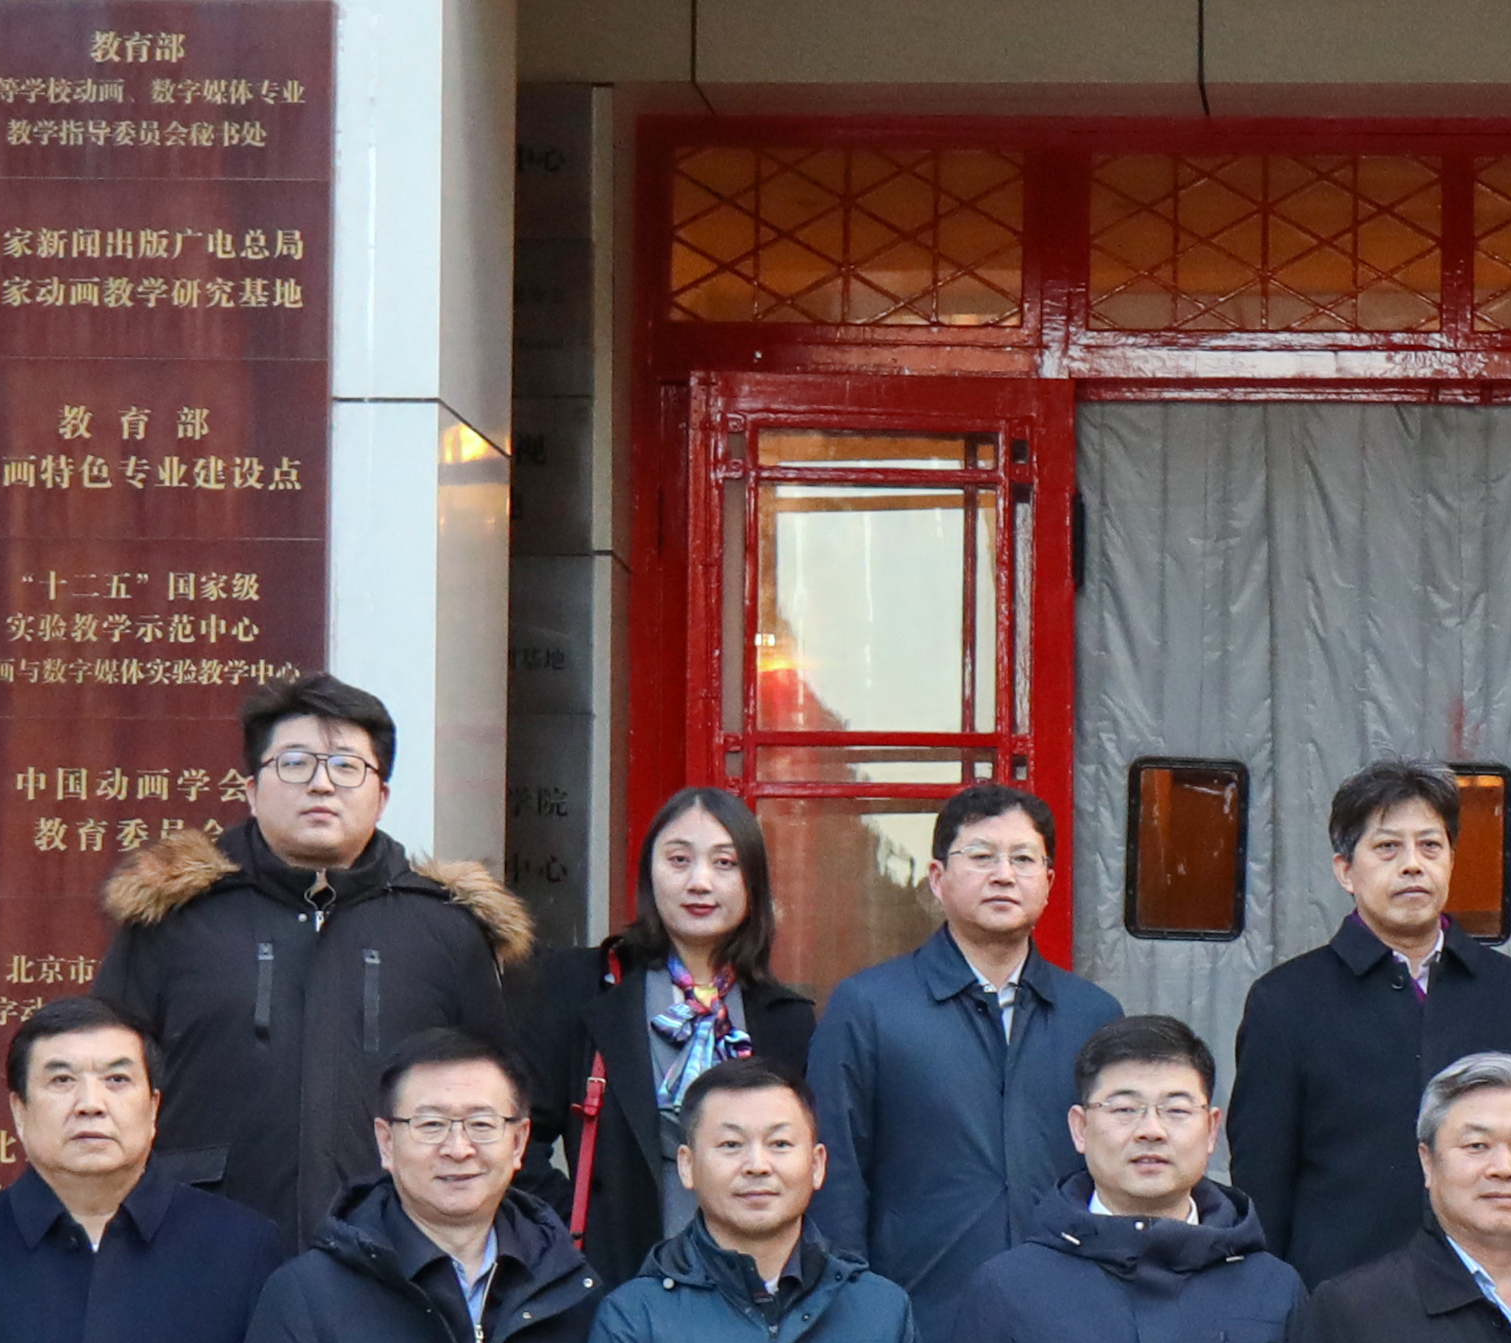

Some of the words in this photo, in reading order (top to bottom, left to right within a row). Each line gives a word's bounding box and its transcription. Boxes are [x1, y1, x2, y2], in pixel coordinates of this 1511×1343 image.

[90, 30, 186, 63] 教育部
[6, 119, 268, 147] 教学指导委员会秘书处
[5, 612, 261, 643] 实验教学示范中心
[15, 767, 248, 802] 中国动画学会
[6, 954, 103, 984] 北京市
